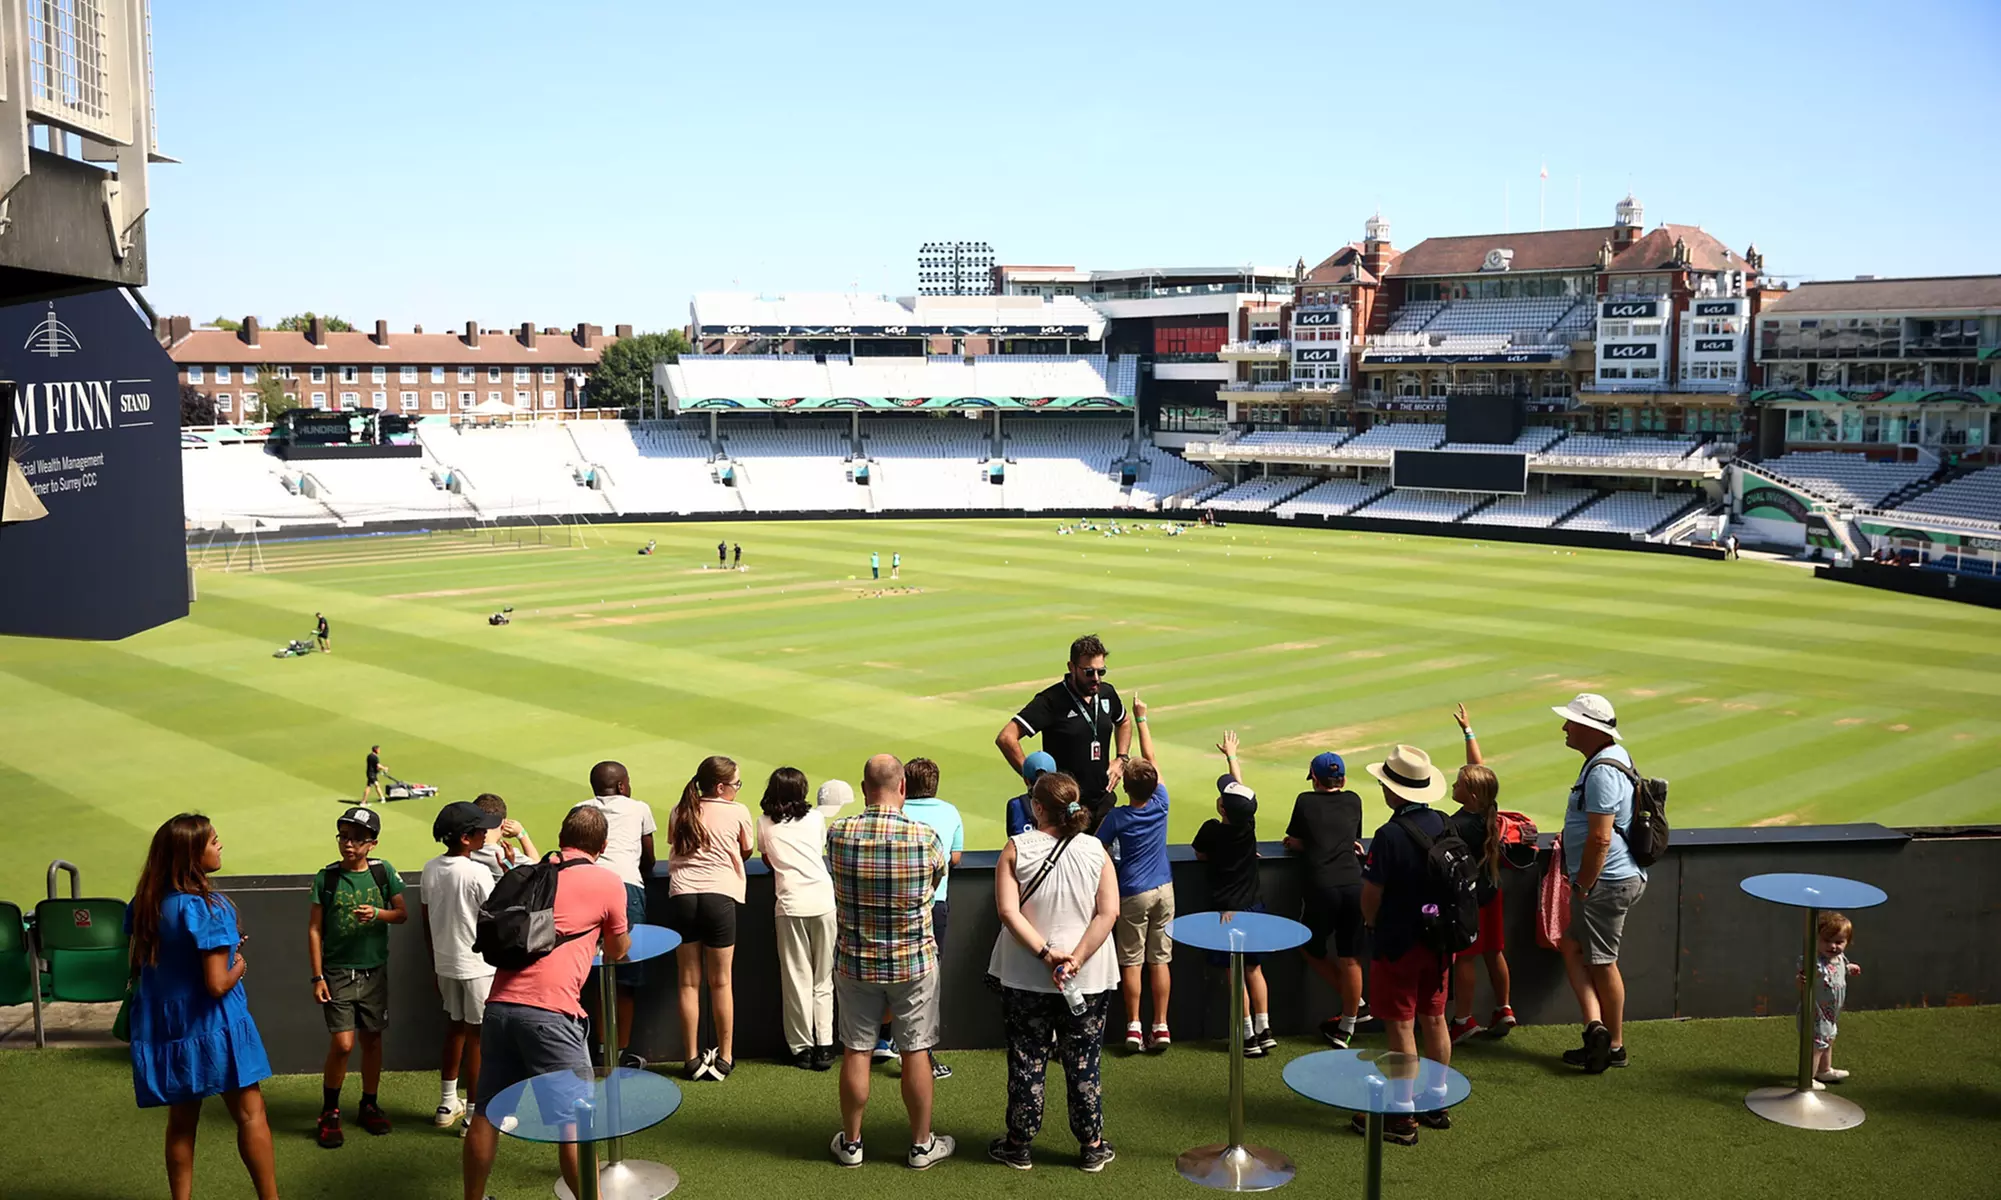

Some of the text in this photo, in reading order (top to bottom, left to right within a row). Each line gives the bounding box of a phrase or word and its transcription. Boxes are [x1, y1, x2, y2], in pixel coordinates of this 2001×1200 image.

[11, 380, 112, 438] M FINN
[120, 393, 150, 412] STAND
[1400, 402, 1412, 411] THE
[1414, 402, 1434, 411] MICKY
[37, 457, 61, 473] Wealth
[62, 452, 104, 472] Management
[51, 479, 59, 493] to
[60, 477, 81, 492] Surrey
[83, 472, 97, 486] CCC
[1968, 537, 2001, 551] HUNDRE
